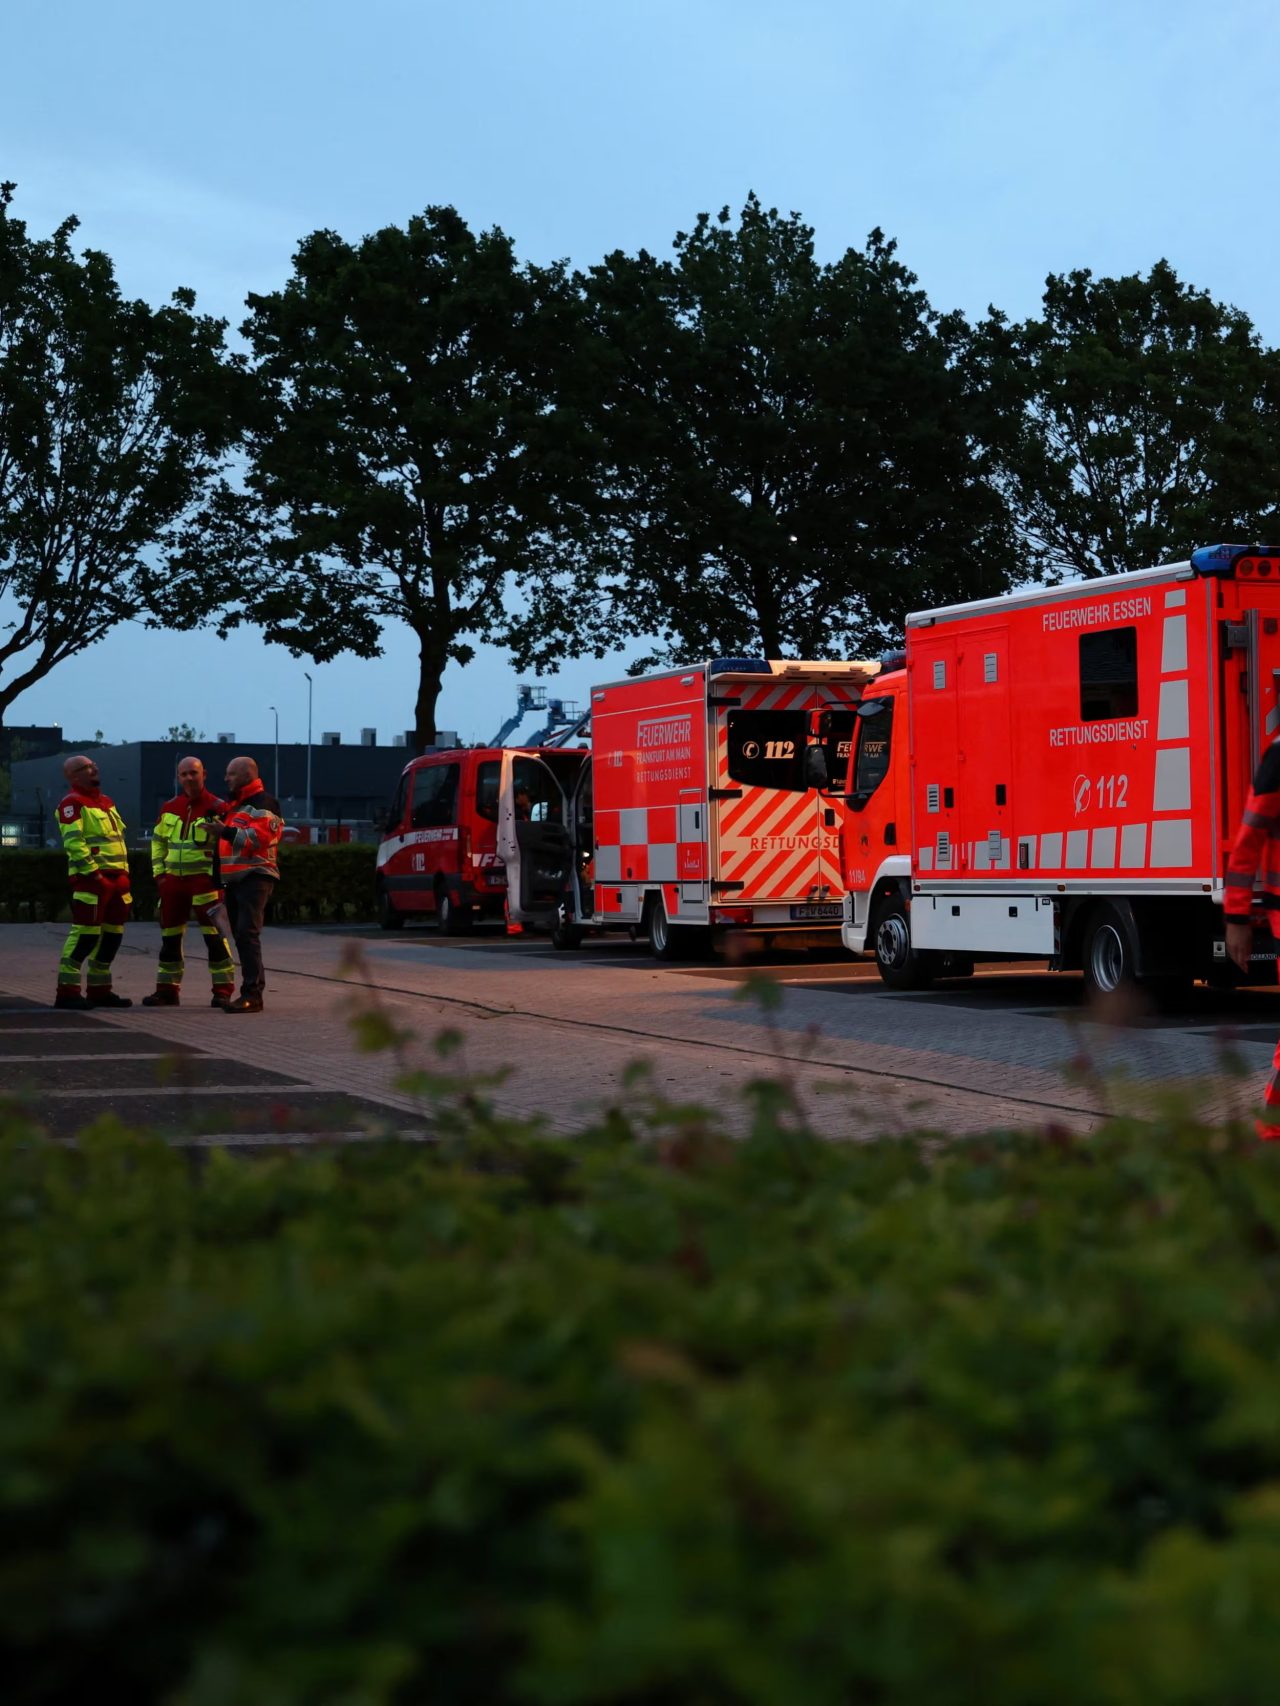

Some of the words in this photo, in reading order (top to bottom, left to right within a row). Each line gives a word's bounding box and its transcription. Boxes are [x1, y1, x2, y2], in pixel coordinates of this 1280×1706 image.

[1043, 604, 1110, 632] FEUERWEHR
[1113, 597, 1151, 623] ESSEN
[637, 714, 692, 748] FEUERWEHR
[1050, 719, 1149, 747] RETTUNGSDIENST
[764, 741, 794, 759] 112
[636, 767, 691, 783] RETTUNGSDIENST
[1097, 774, 1128, 809] 112
[750, 836, 839, 849] RETTUNGSD
